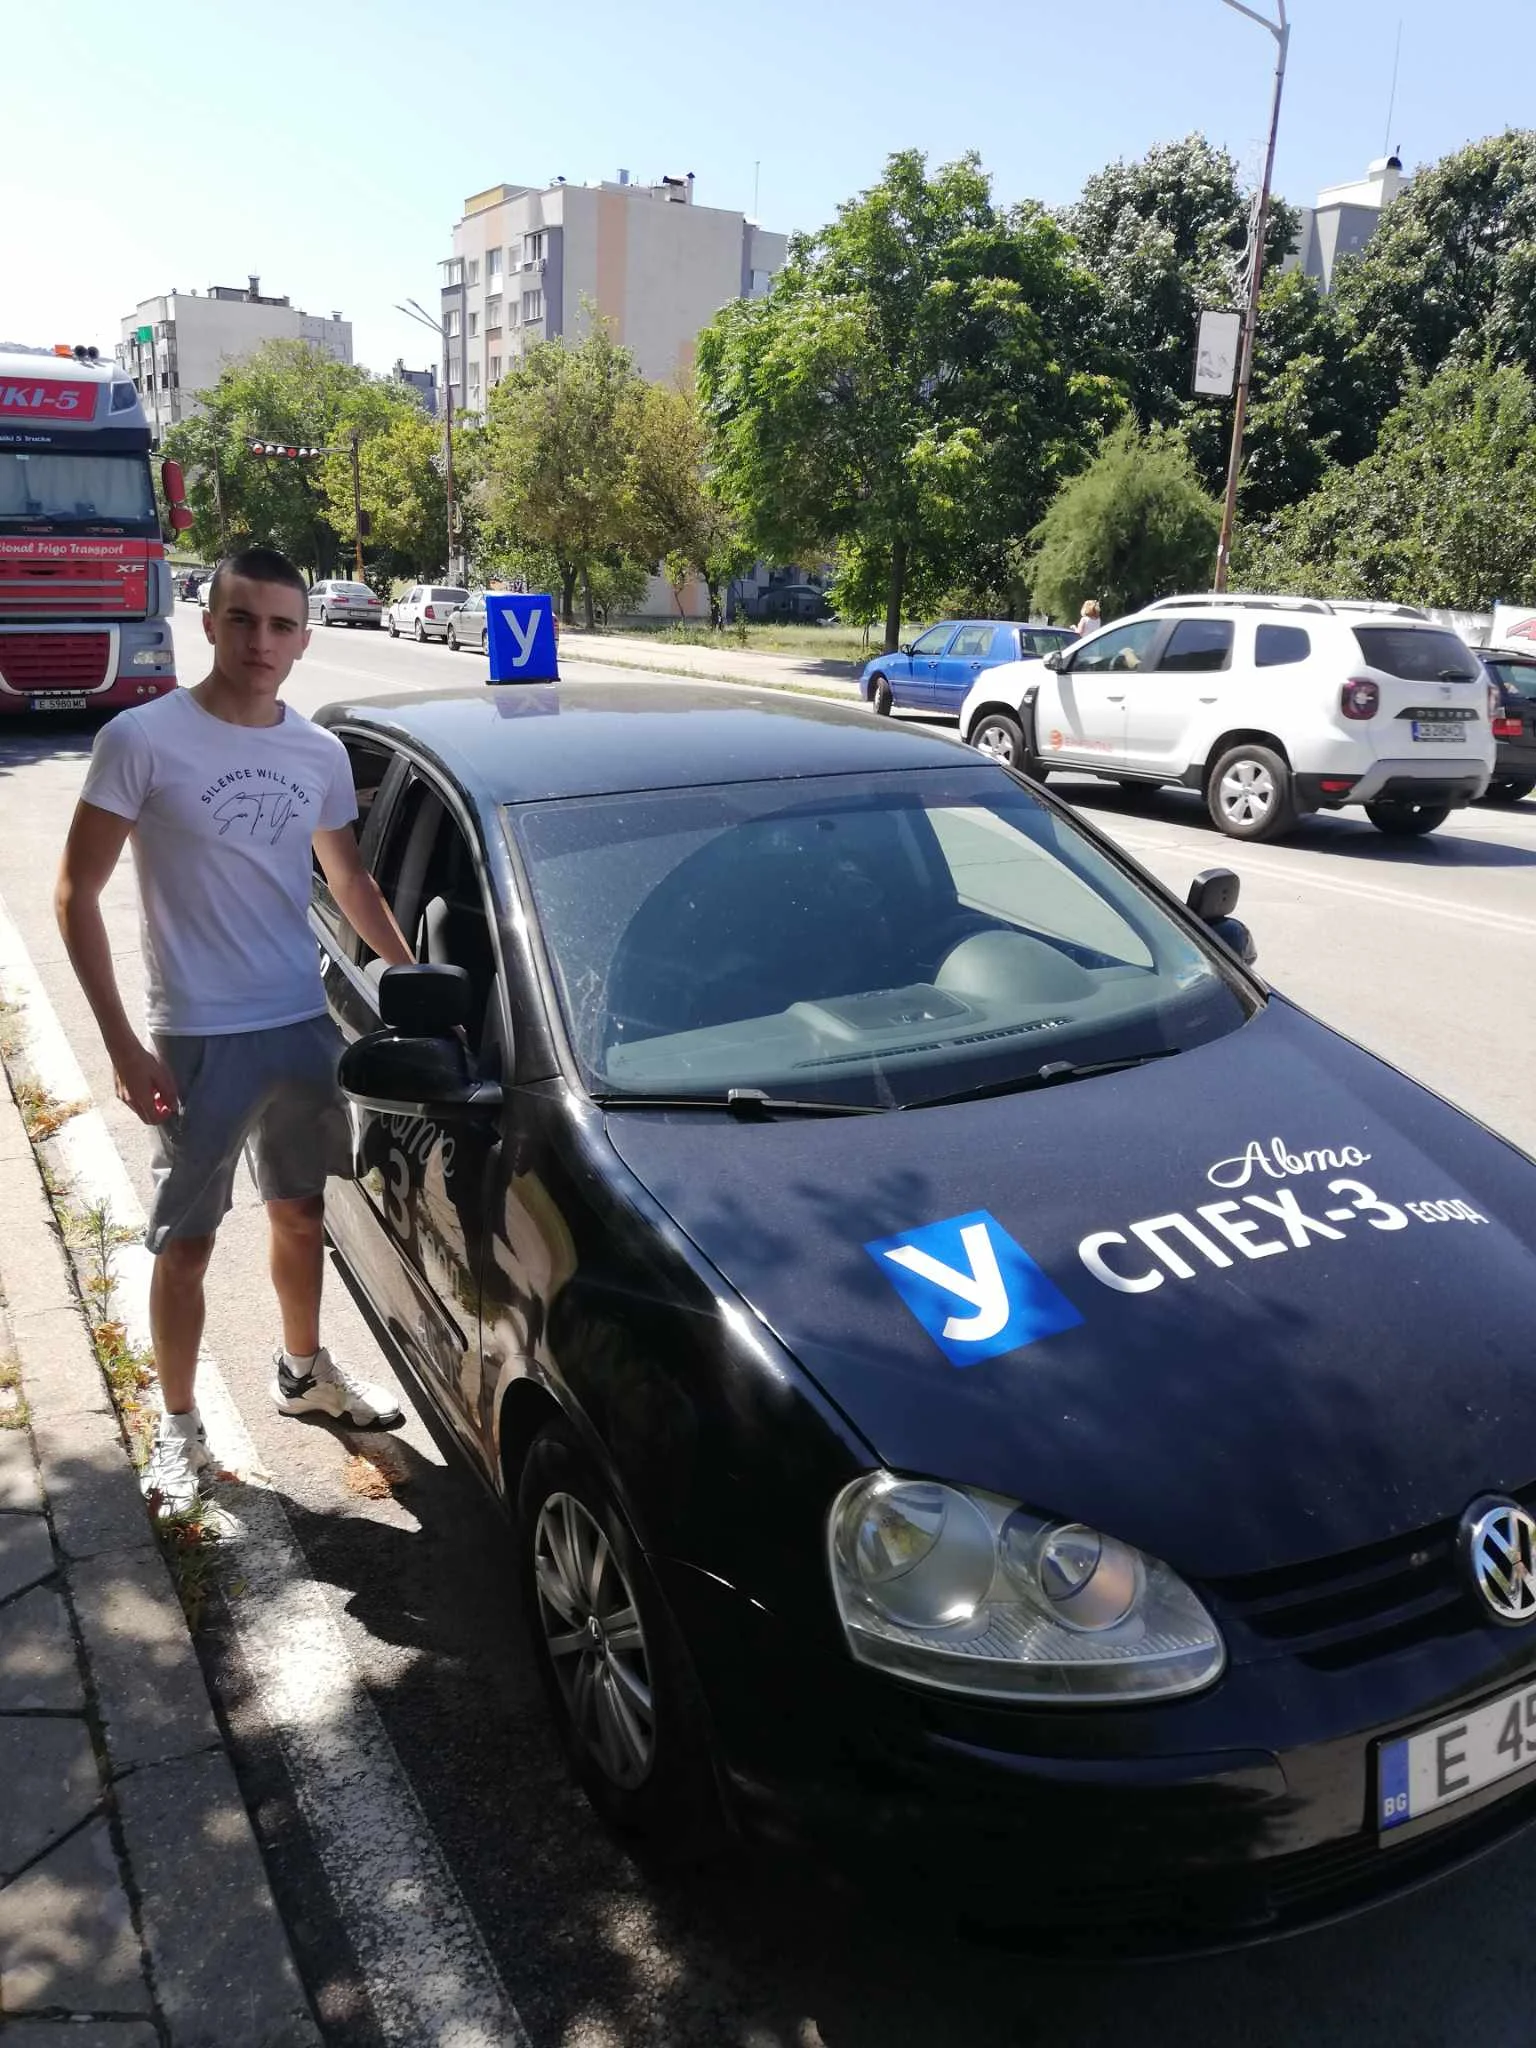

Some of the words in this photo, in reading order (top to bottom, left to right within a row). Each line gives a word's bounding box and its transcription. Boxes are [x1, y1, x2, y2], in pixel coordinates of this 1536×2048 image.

[0, 385, 79, 410] KI-5
[70, 543, 124, 556] Transport
[116, 564, 145, 573] XF
[201, 768, 253, 805] SILENCE
[256, 768, 287, 786] WILL
[290, 783, 312, 806] NOT
[1078, 1178, 1409, 1294] СПЕХ-3
[1403, 1198, 1491, 1225] ЕООД
[1384, 1792, 1407, 1818] BG
[1436, 1724, 1470, 1798] E
